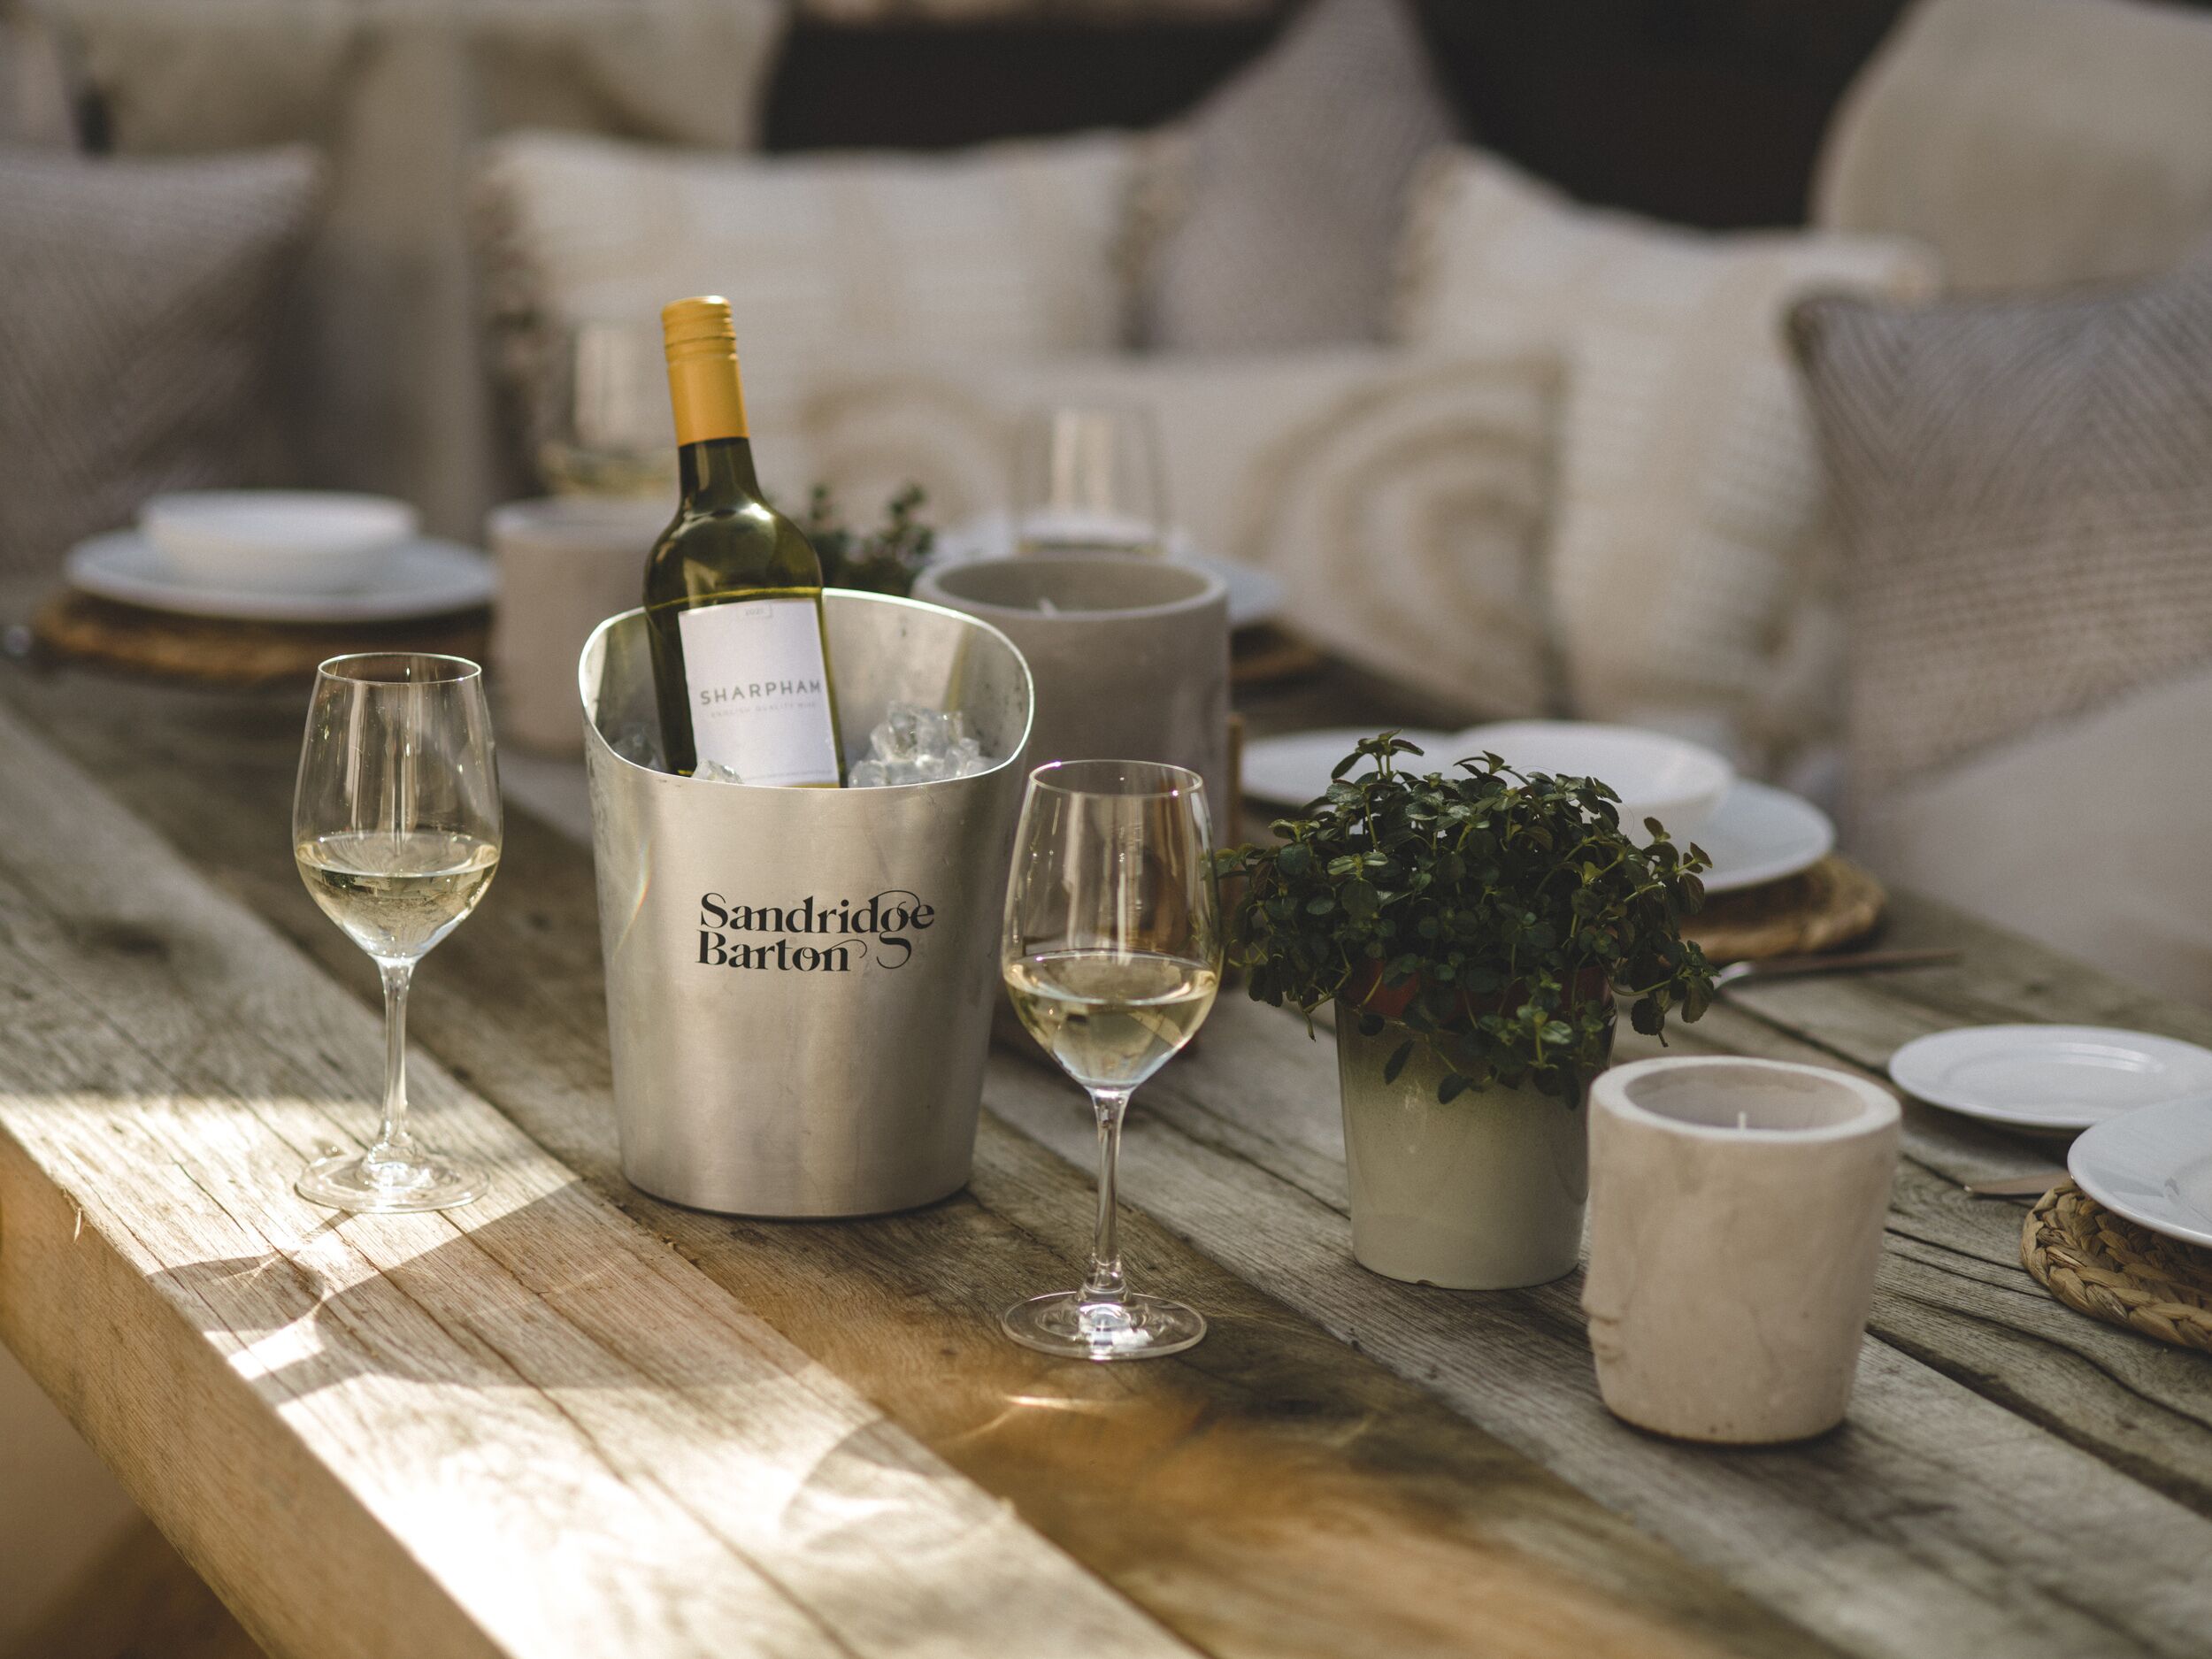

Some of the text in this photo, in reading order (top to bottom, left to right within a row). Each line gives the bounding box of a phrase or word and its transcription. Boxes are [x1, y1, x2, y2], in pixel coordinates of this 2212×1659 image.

[700, 679, 821, 705] SHARPHAM
[695, 929, 867, 972] Barton
[700, 889, 935, 970] Sandridge
